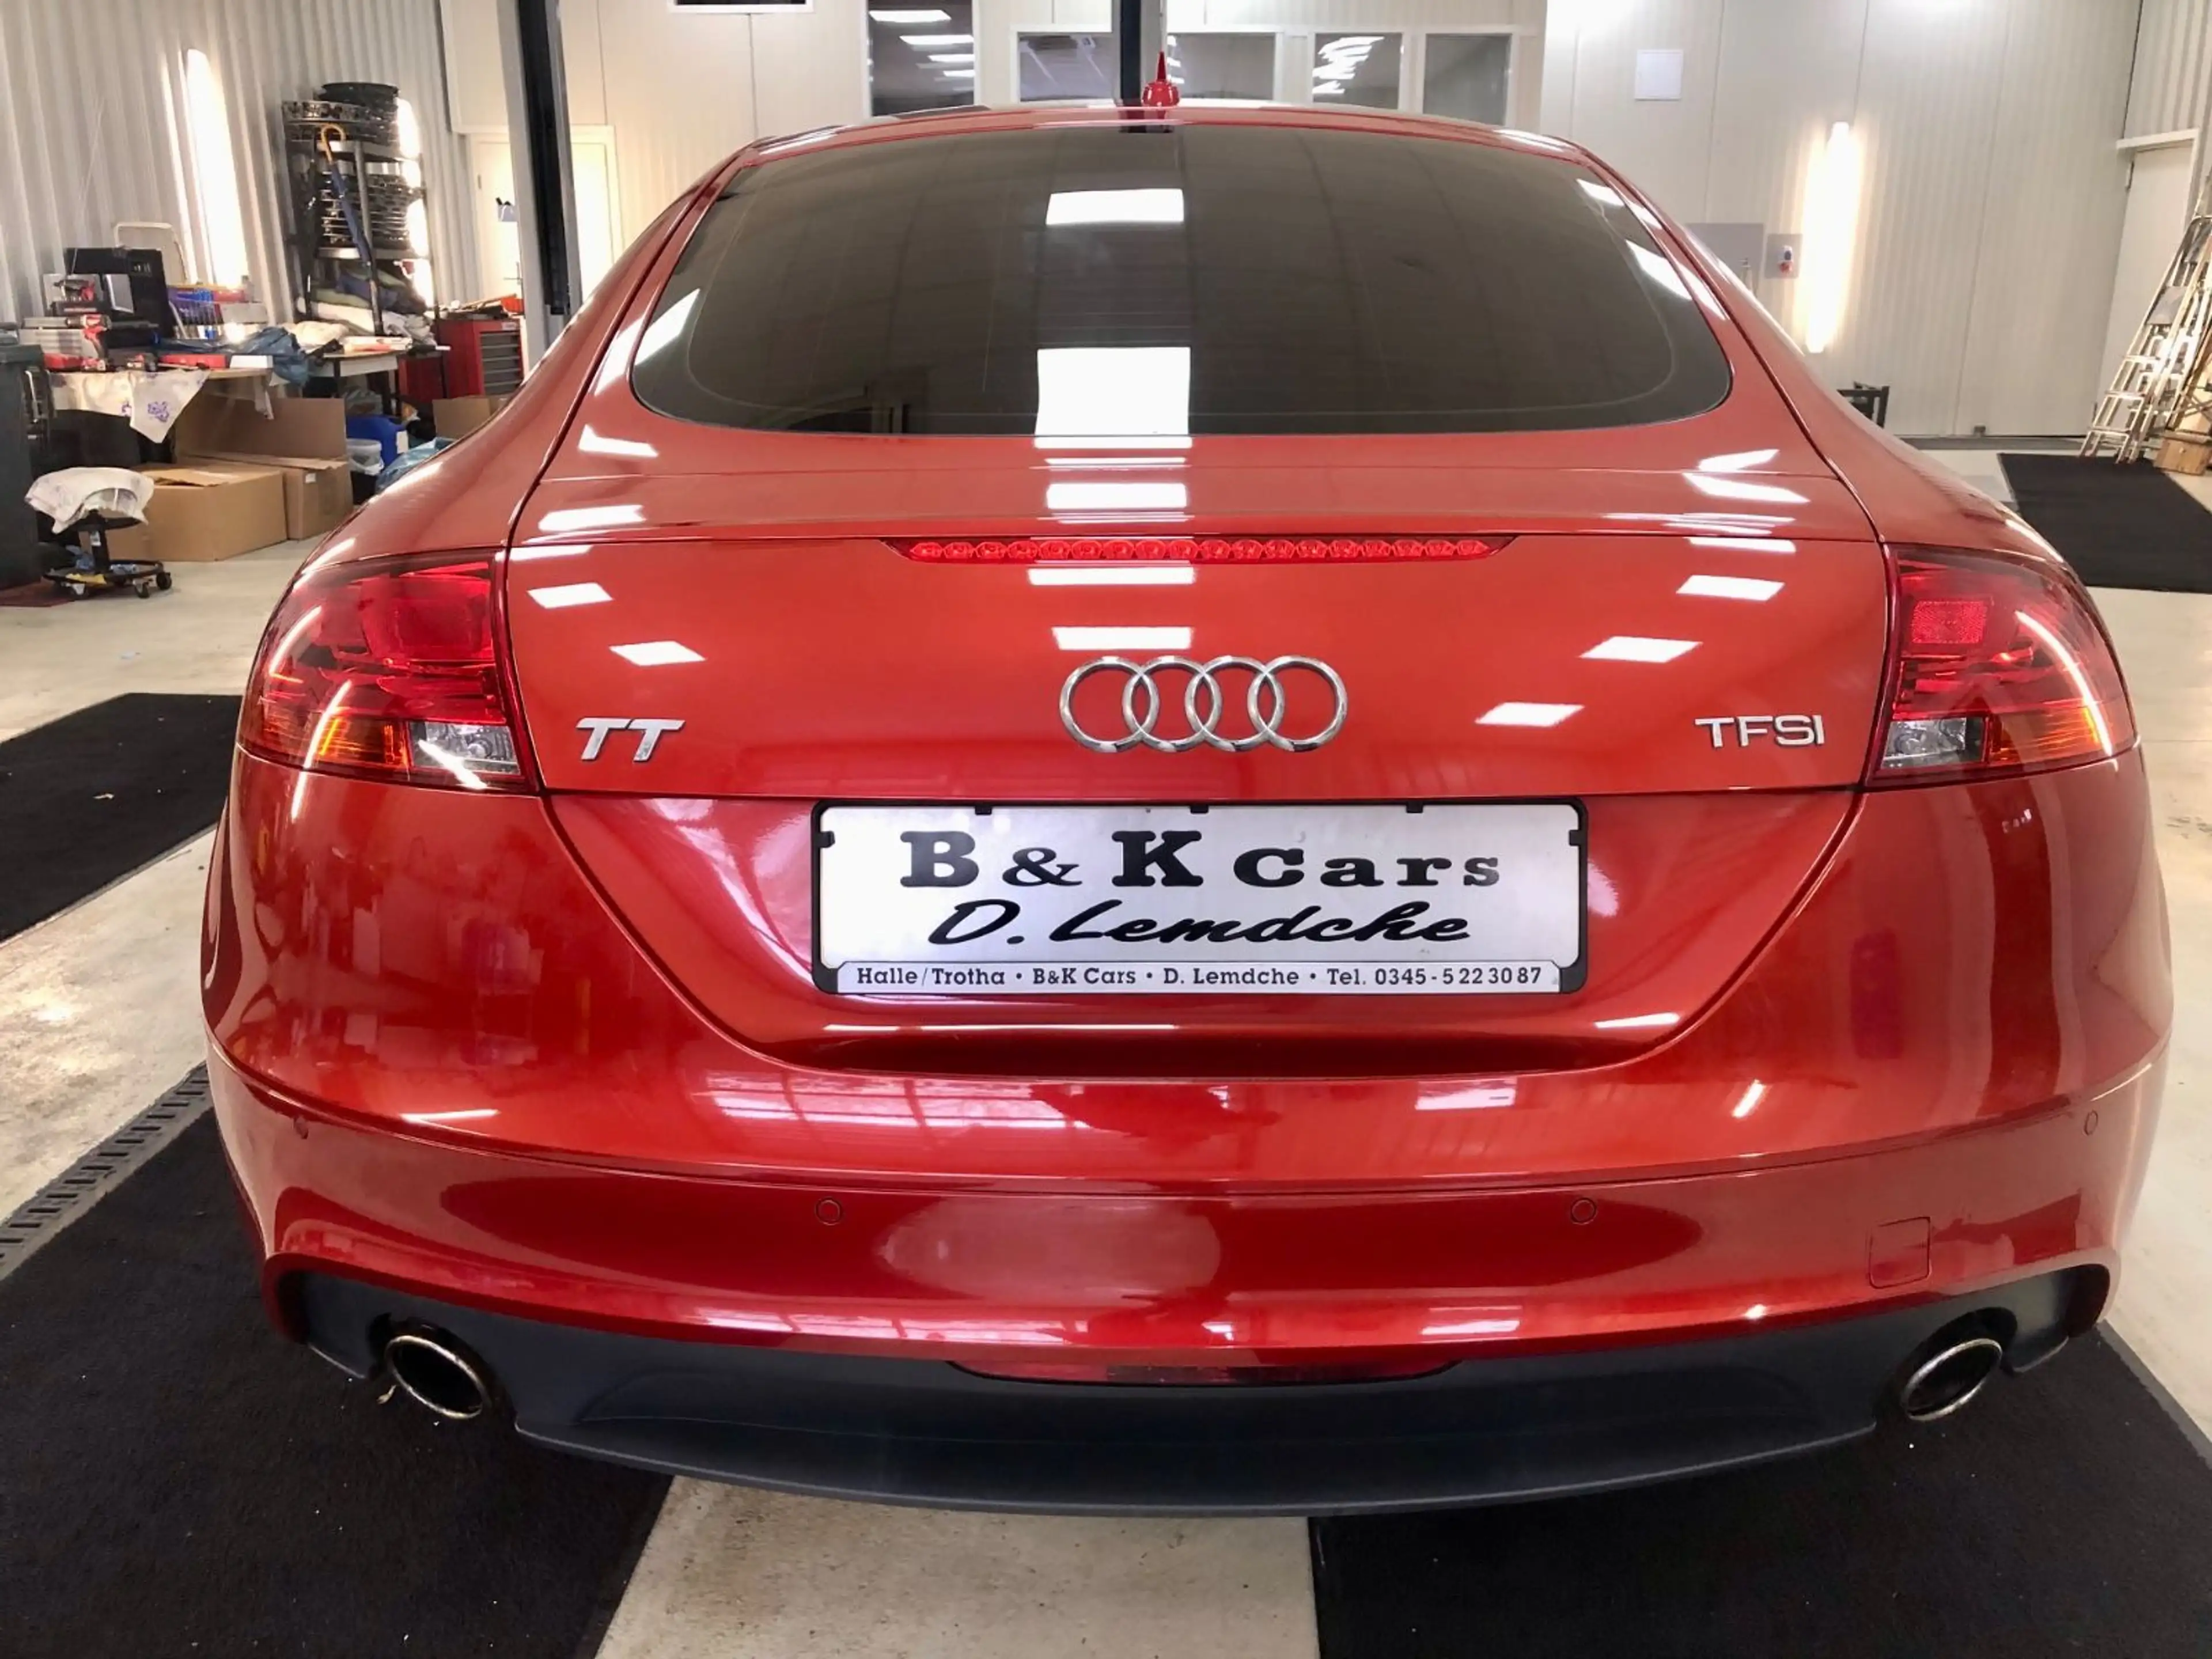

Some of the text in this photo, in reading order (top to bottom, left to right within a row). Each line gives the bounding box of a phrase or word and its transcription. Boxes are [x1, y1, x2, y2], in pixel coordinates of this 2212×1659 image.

[575, 717, 686, 762] TT
[1694, 714, 1825, 748] TFSI
[900, 830, 1500, 888] B & K Cars
[927, 898, 1471, 945] D. Lemdche
[1032, 967, 1077, 984] B&K
[1083, 967, 1136, 984] Cars
[1163, 967, 1185, 984] D.
[1192, 967, 1300, 985] Lemdche
[1327, 968, 1367, 986] Tel.
